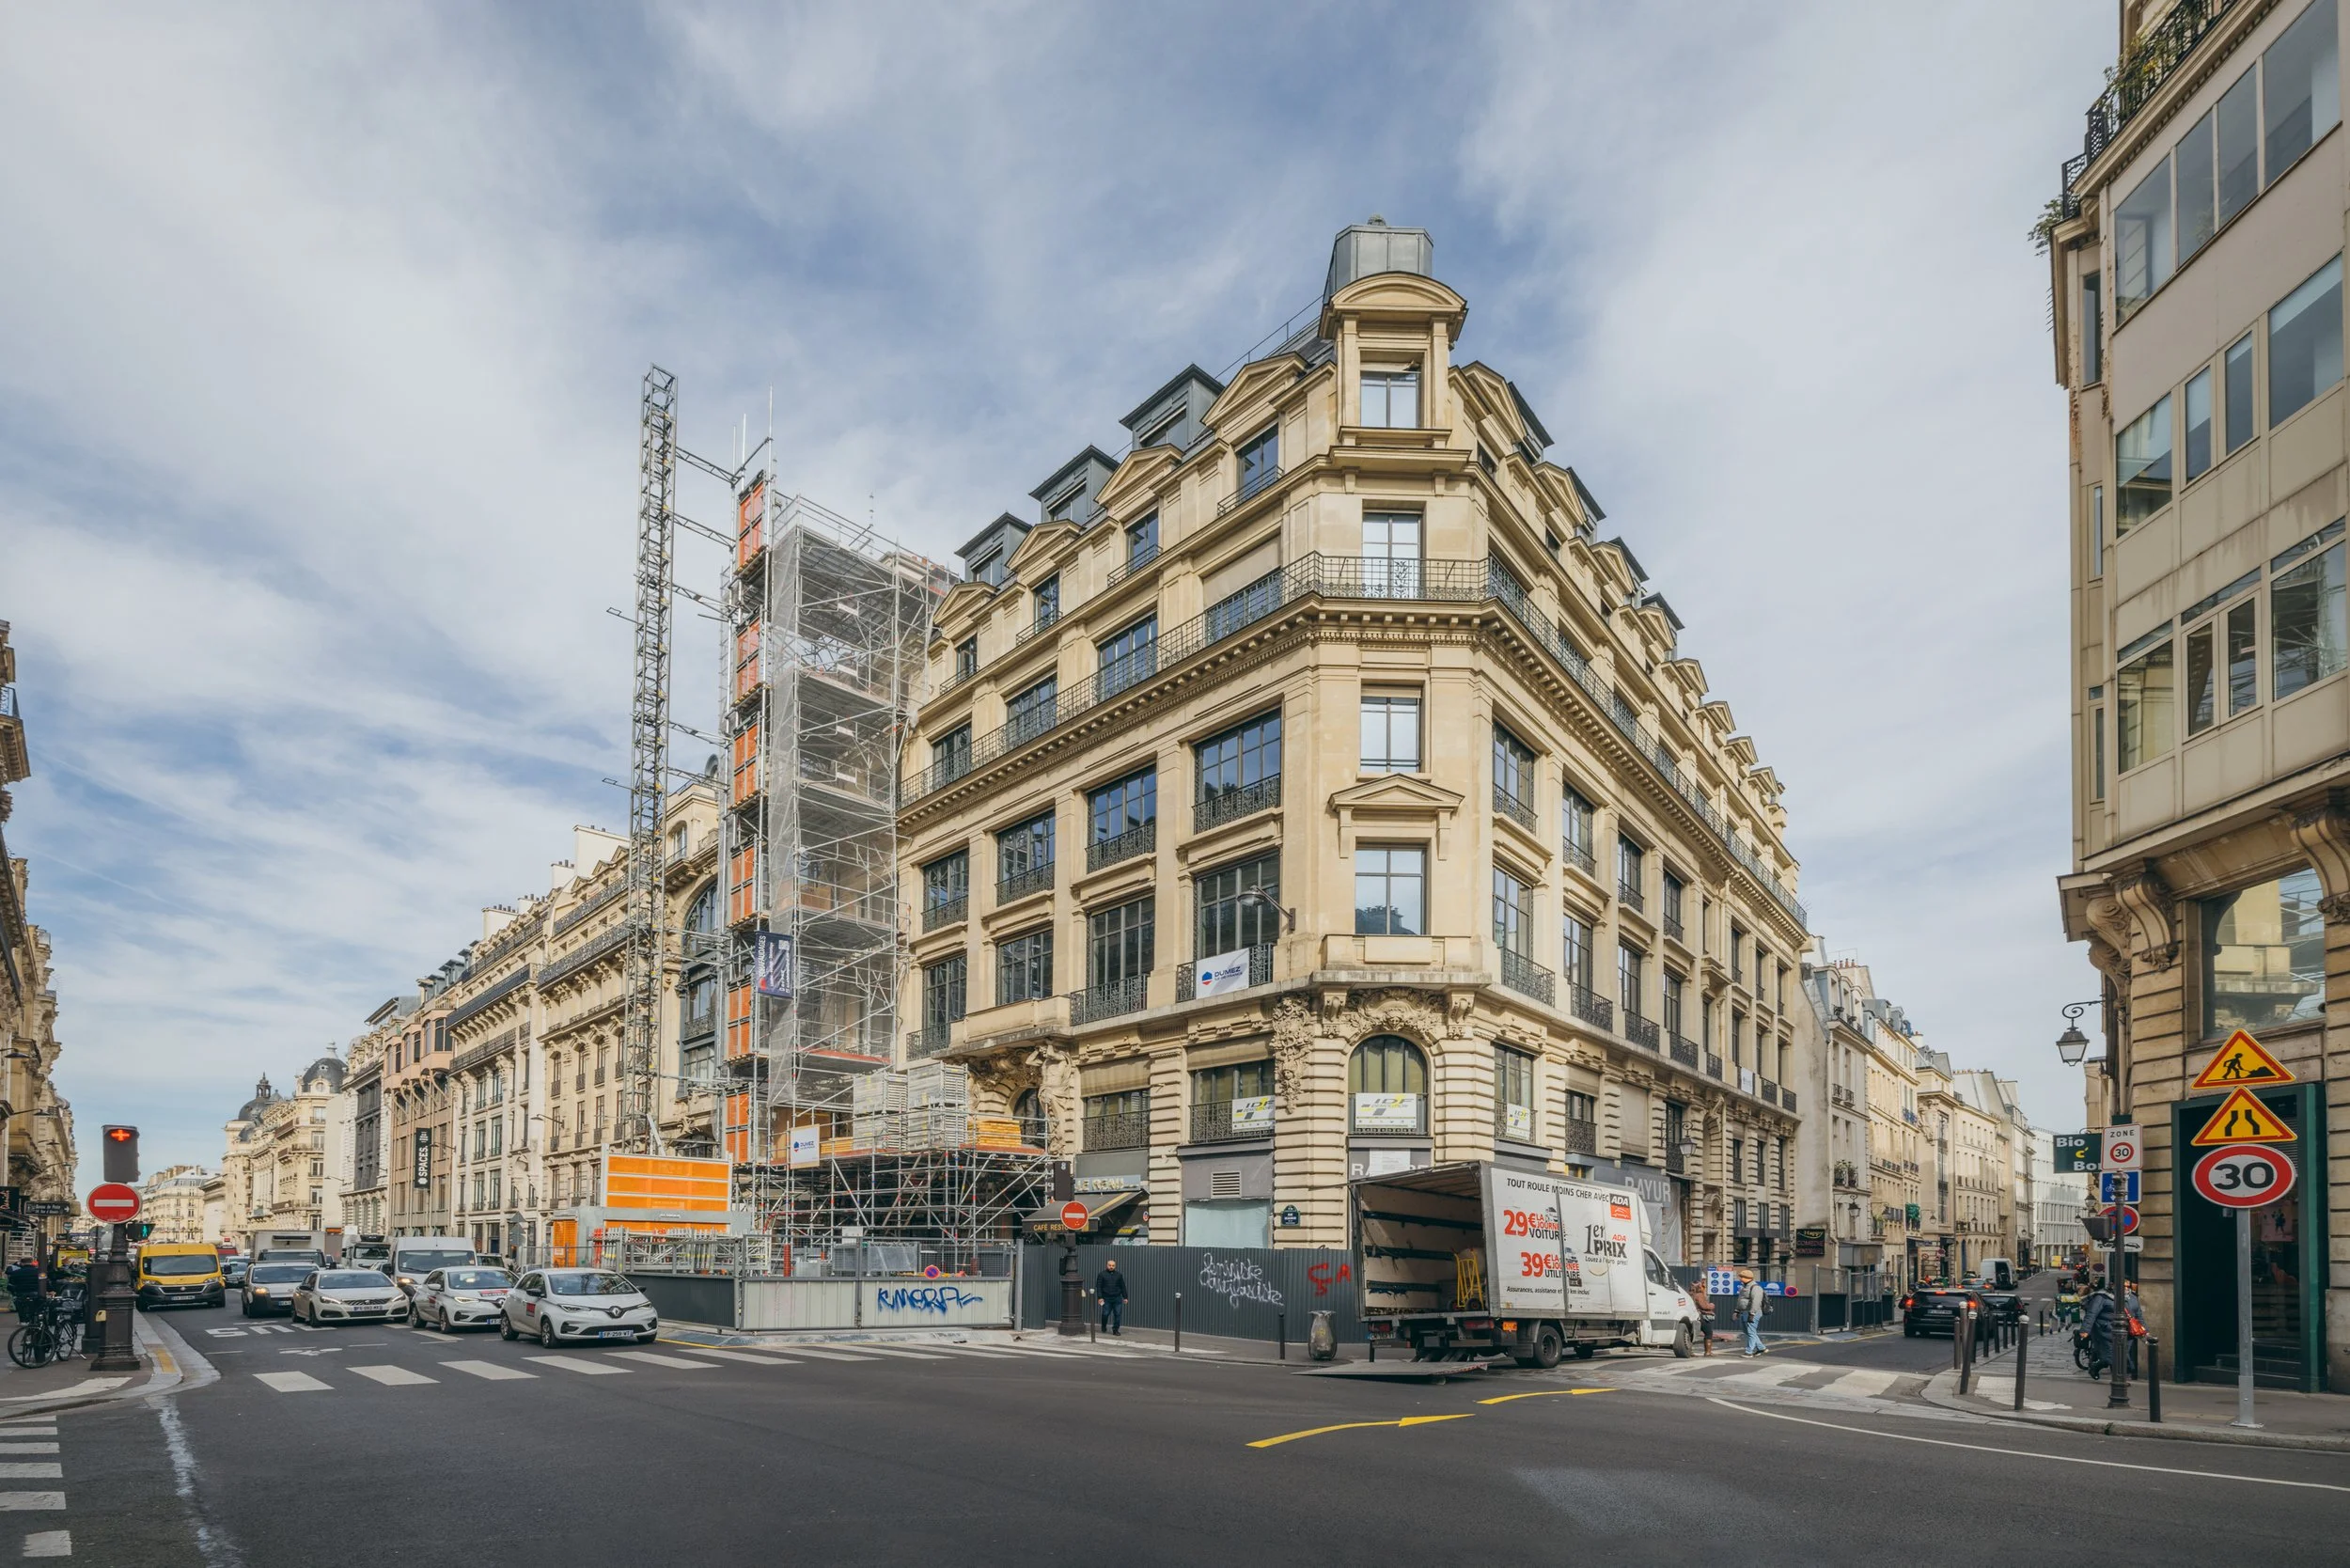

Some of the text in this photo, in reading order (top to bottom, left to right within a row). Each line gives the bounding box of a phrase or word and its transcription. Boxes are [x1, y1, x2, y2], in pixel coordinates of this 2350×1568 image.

[1214, 965, 1241, 977] DUMEZ
[2110, 1129, 2135, 1138] ZONE
[2056, 1137, 2085, 1147] Bio
[2115, 1148, 2129, 1157] 30
[2214, 1162, 2275, 1190] 30
[1507, 1178, 1628, 1206] TOUT ROULE MOINS CHER AVEC ADA
[1503, 1209, 1536, 1237] 29€
[1529, 1228, 1567, 1241] VOITUR
[1584, 1224, 1605, 1255] 1er
[1612, 1233, 1627, 1242] ADA
[1593, 1239, 1627, 1259] PRIX
[1520, 1251, 1552, 1278] 39€
[1544, 1269, 1580, 1279] UTILIAIRE
